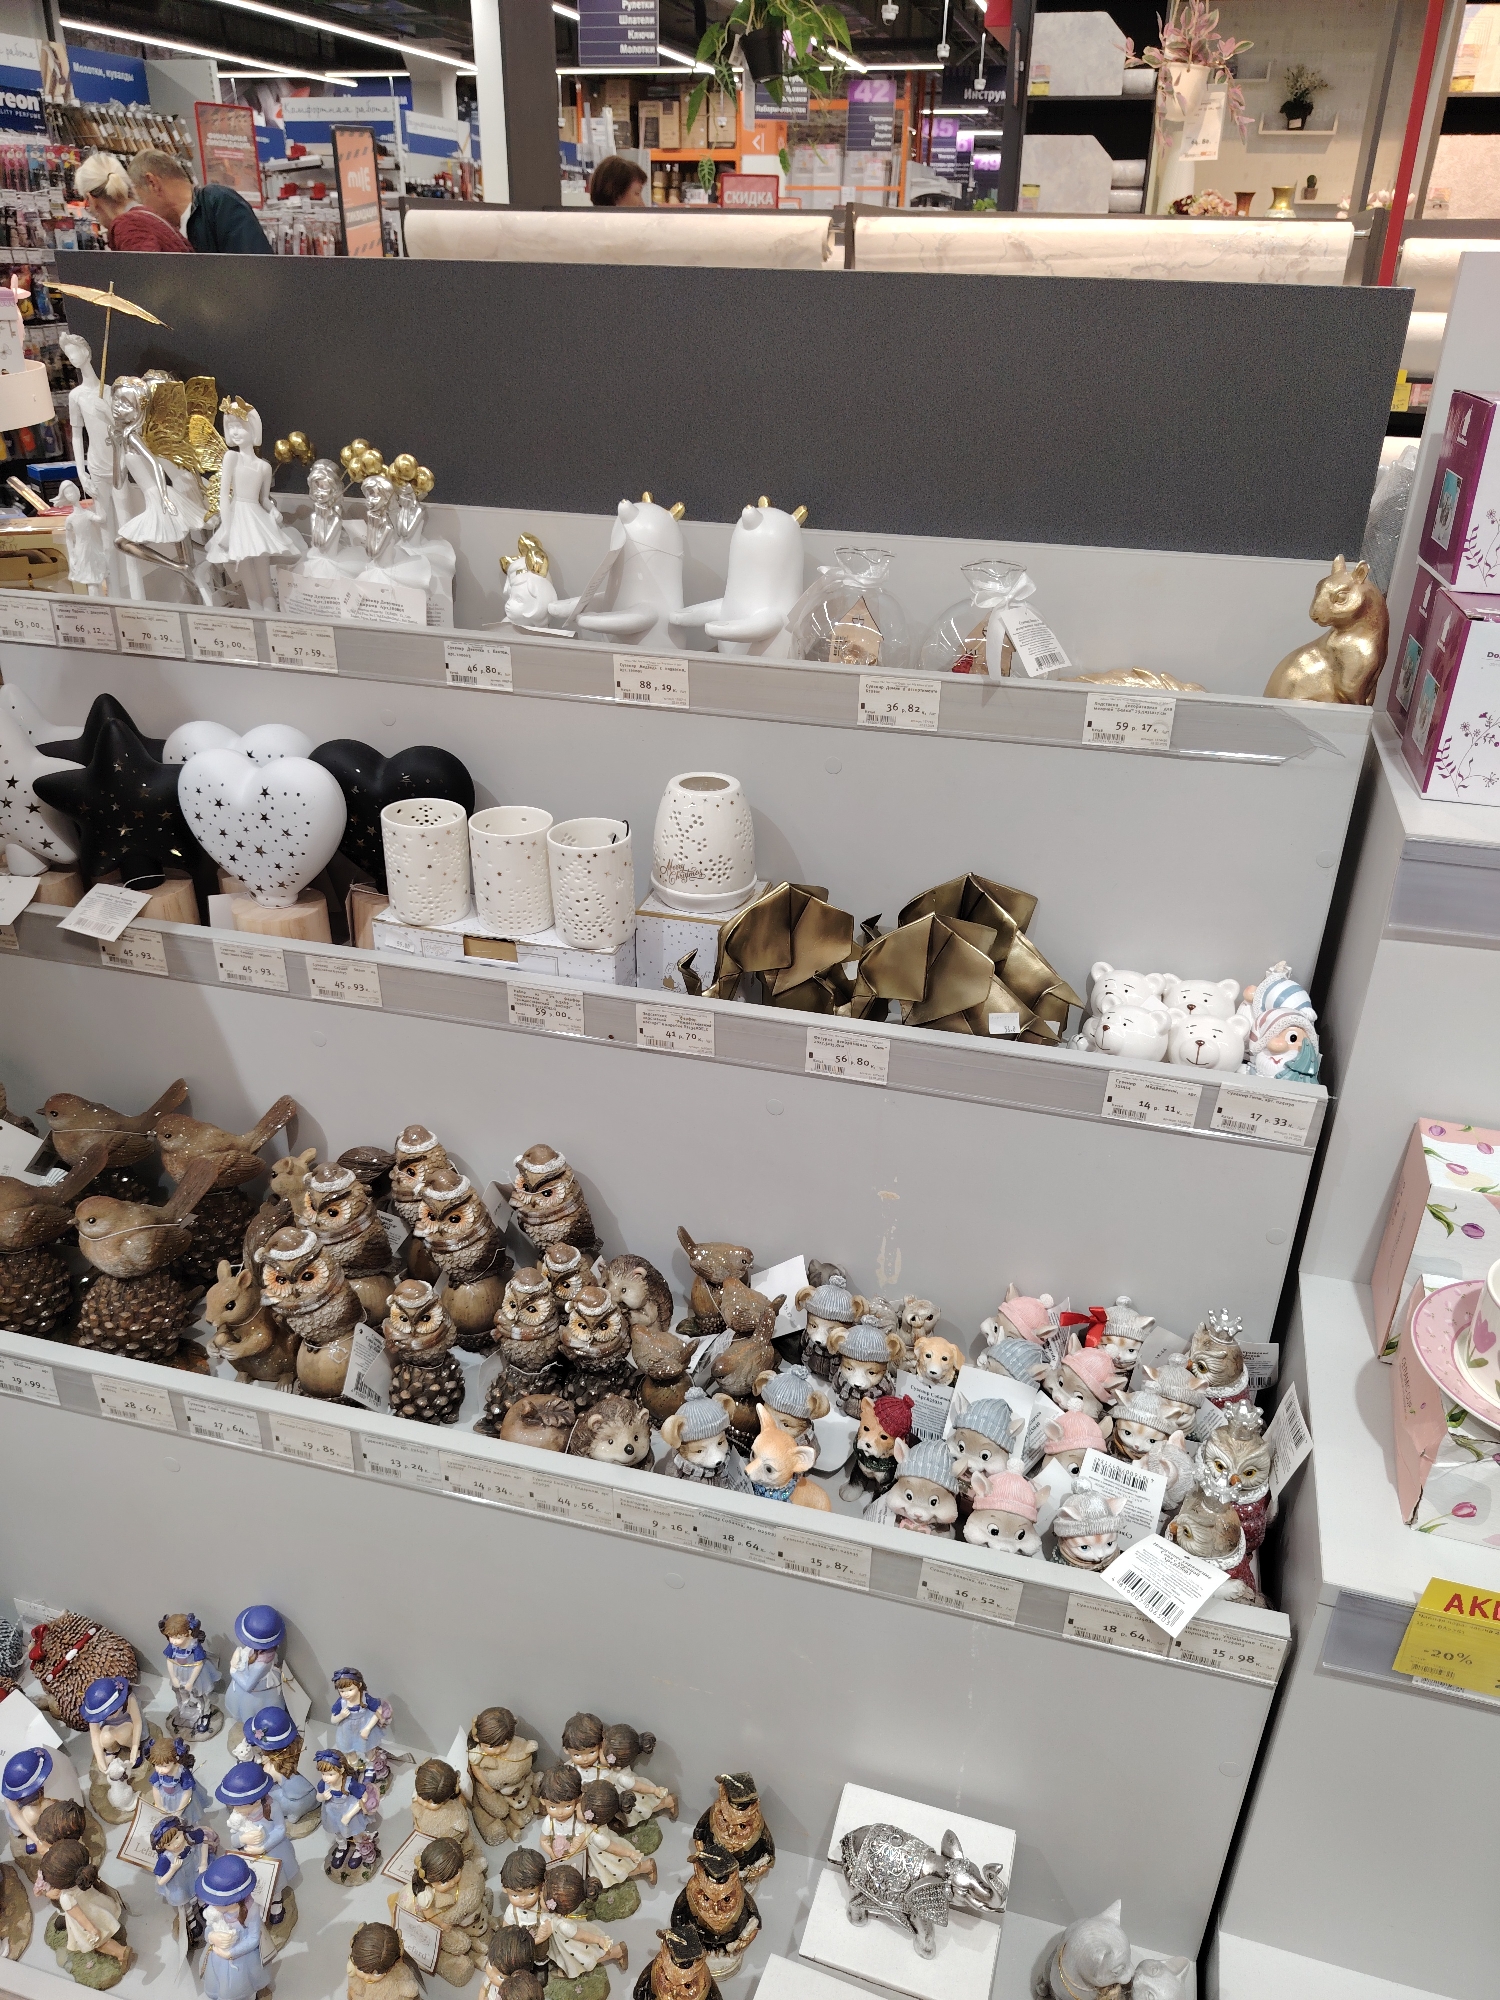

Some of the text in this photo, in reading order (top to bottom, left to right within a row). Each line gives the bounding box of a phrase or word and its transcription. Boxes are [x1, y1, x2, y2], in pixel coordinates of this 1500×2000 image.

[619, 15, 655, 25] Шпатели
[628, 30, 655, 39] Ключи
[620, 44, 655, 54] Молотки
[854, 80, 890, 102] 42
[724, 191, 774, 206] СКИДКА
[214, 639, 224, 648] 63
[294, 648, 321, 657] 57 59
[468, 664, 478, 673] 46
[640, 681, 671, 692] 88 19
[887, 703, 920, 712] 36 82
[1116, 722, 1152, 732] 59 17
[660, 859, 685, 874] Merry
[354, 984, 364, 992] 93
[536, 1008, 546, 1016] 59
[836, 1055, 869, 1066] 56 80
[1139, 1101, 1150, 1110] 14
[1250, 1113, 1262, 1121] 17
[1273, 1118, 1288, 1126] 33
[146, 1405, 157, 1414] 67
[233, 1424, 244, 1435] 64
[323, 1445, 334, 1455] 85
[411, 1464, 423, 1472] 24
[495, 1486, 507, 1494] 34
[558, 1497, 570, 1506] 44
[745, 1541, 759, 1551] 64
[811, 1558, 849, 1572] 15 87
[1130, 1630, 1145, 1642] 64
[1213, 1649, 1255, 1664] 15 98
[1424, 1649, 1472, 1665] -20%
[405, 1945, 427, 1960] efard
